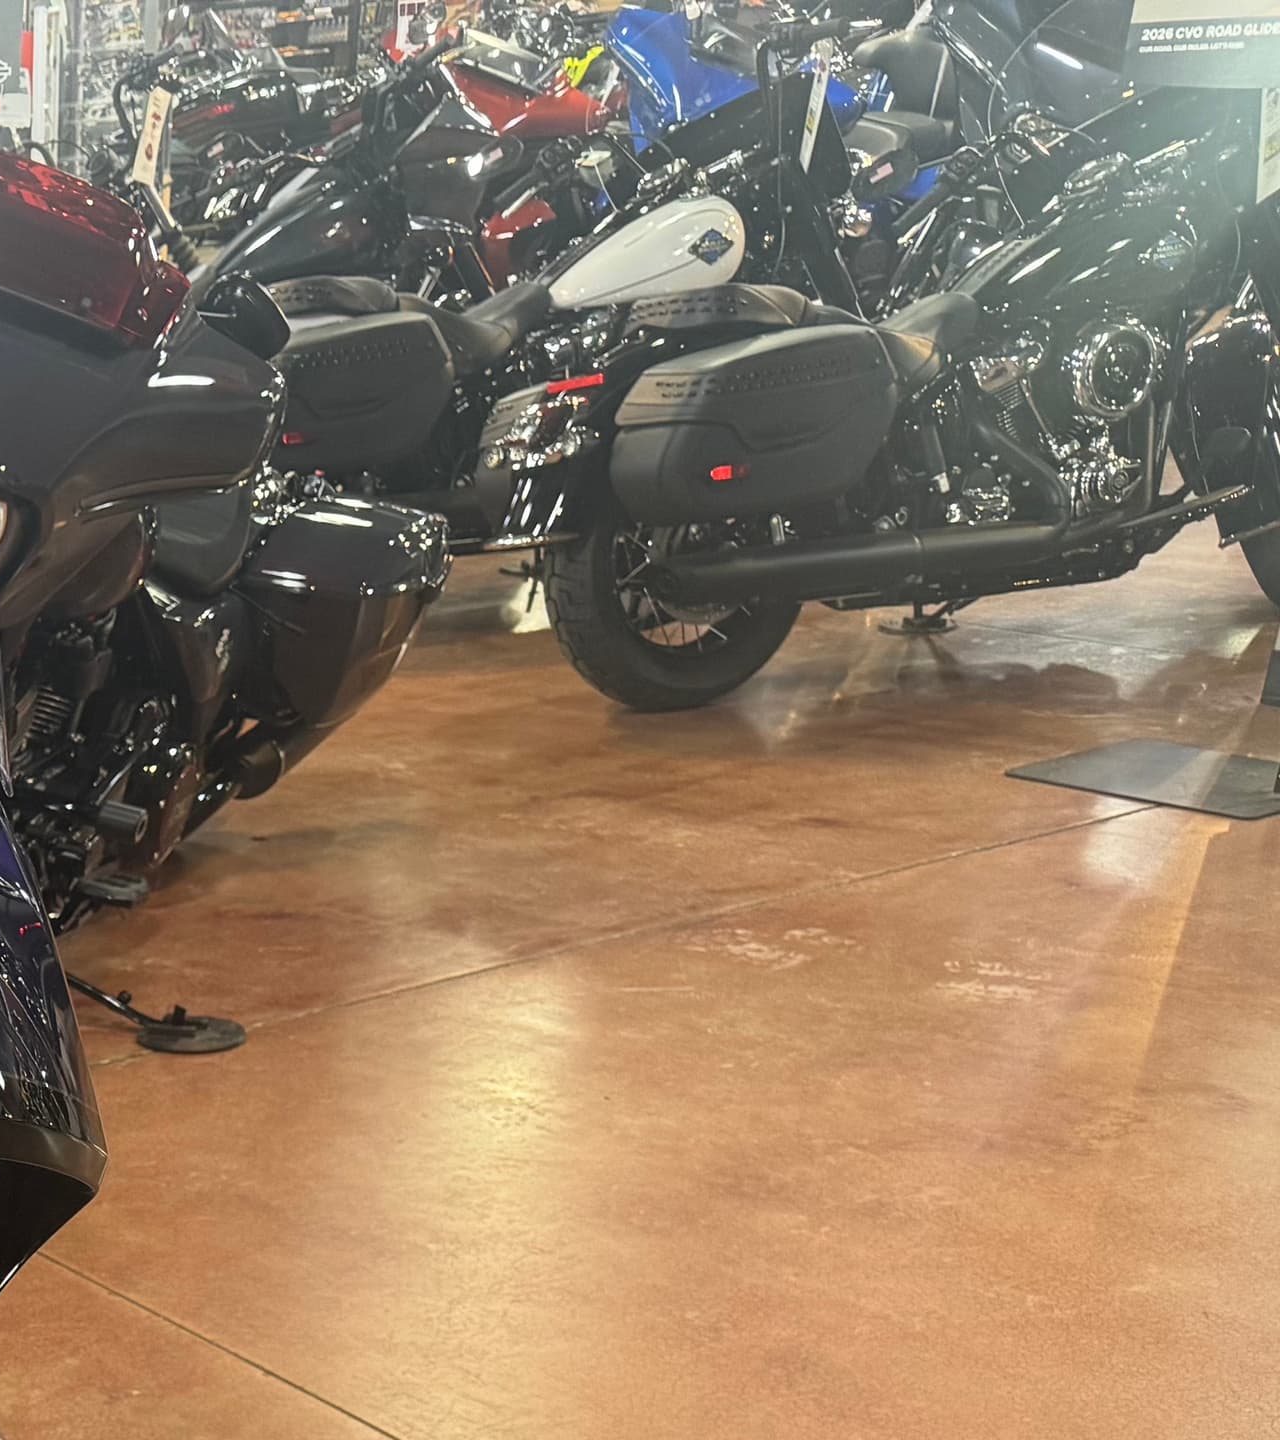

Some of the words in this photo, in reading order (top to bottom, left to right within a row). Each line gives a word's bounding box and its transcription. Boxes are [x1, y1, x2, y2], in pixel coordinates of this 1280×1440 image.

[1141, 27, 1173, 41] 2026
[1175, 26, 1204, 39] CVO
[1205, 24, 1242, 38] ROAD
